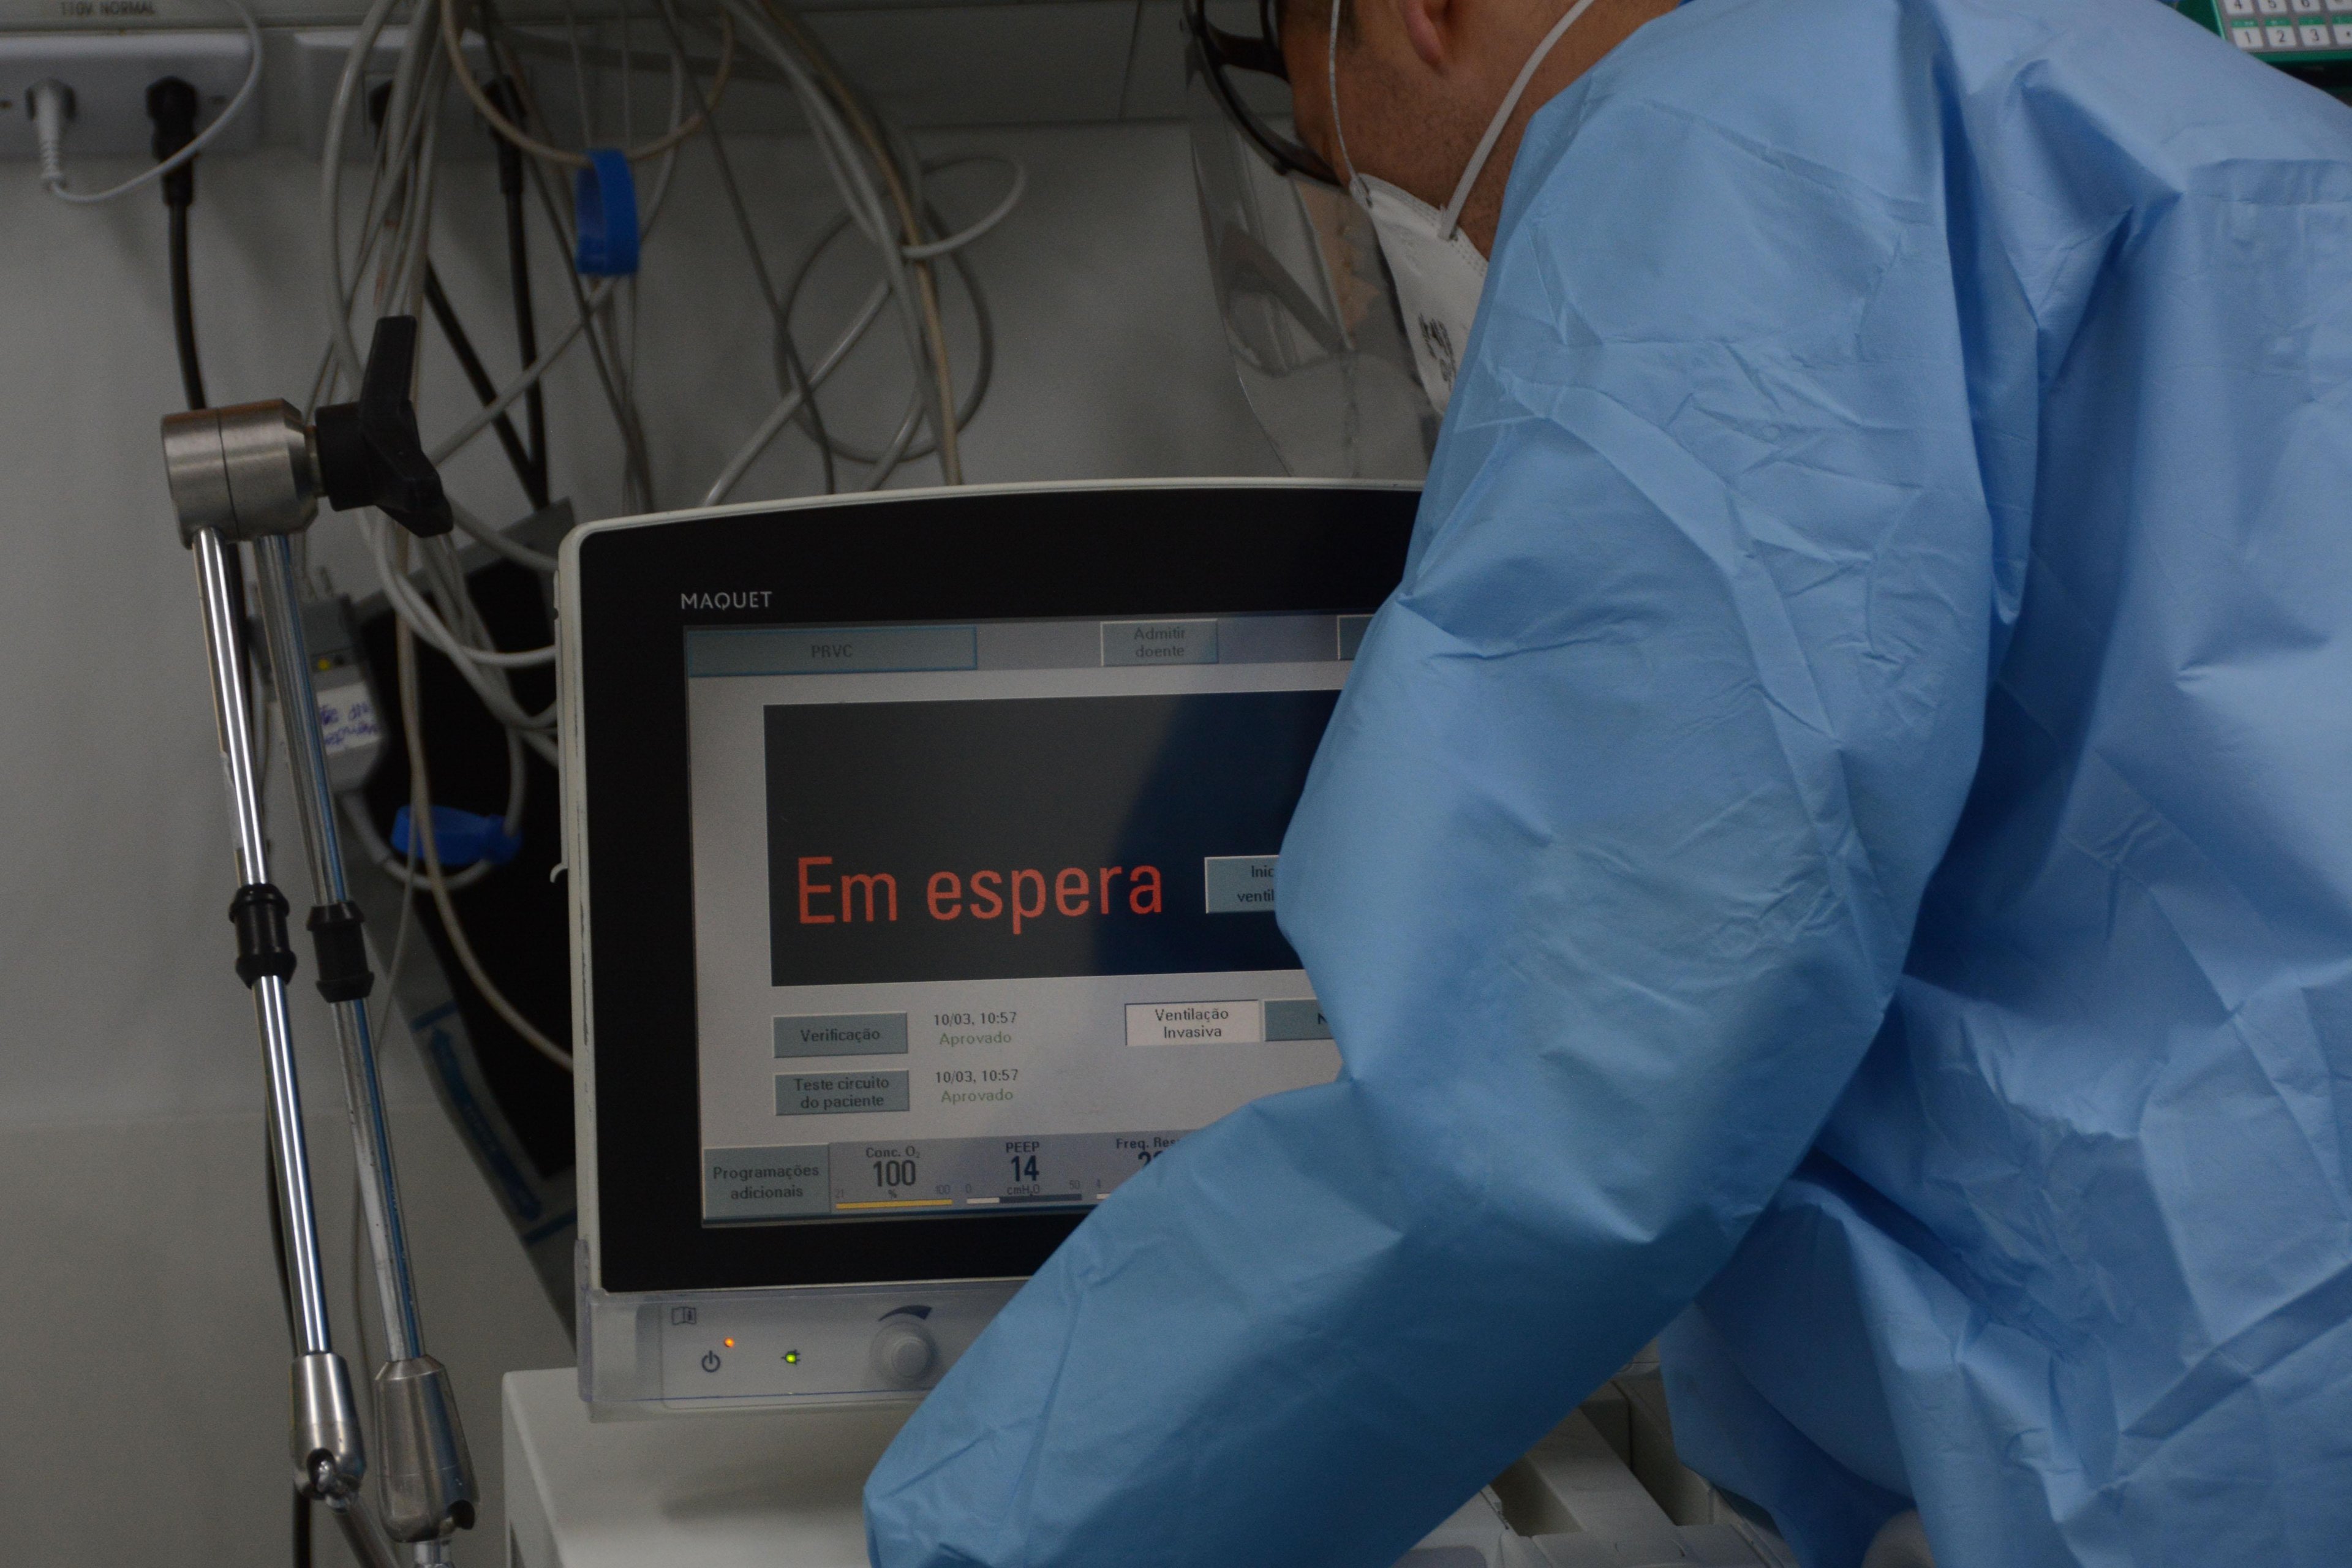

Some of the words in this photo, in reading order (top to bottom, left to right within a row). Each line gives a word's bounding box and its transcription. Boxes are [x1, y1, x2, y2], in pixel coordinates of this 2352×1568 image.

[100, 1, 156, 15] NORMAL
[2277, 29, 2285, 42] 2
[2310, 28, 2319, 42] 3
[681, 591, 772, 611] MAQUET
[1134, 627, 1185, 641] Admitir
[812, 644, 853, 658] PRVC
[1136, 645, 1185, 658] doente
[1251, 865, 1274, 878] Inic
[798, 856, 898, 924] Em
[926, 863, 1163, 935] espera
[981, 1011, 1017, 1024] 10:57
[1155, 1008, 1229, 1022] Ventilação
[800, 1027, 880, 1044] Verificação
[939, 1031, 1012, 1047] Aprovado
[1164, 1025, 1222, 1039] Invasiva
[982, 1069, 1019, 1082] 10:57
[793, 1077, 834, 1091] Teste
[838, 1076, 890, 1090] circuito
[801, 1096, 820, 1109] do
[824, 1095, 884, 1110] paciente
[941, 1088, 1014, 1104] Aprovado
[1005, 1141, 1040, 1153] PEEP
[1115, 1138, 1149, 1151] Freq.
[1154, 1137, 1180, 1148] Res
[866, 1147, 901, 1158] Conc.
[1137, 1150, 1163, 1167] 2
[712, 1164, 820, 1180] Programações
[873, 1159, 916, 1188] 100
[1011, 1155, 1040, 1182] 14
[730, 1185, 804, 1199] adicionais
[935, 1185, 951, 1195] 100
[1069, 1180, 1080, 1190] 50
